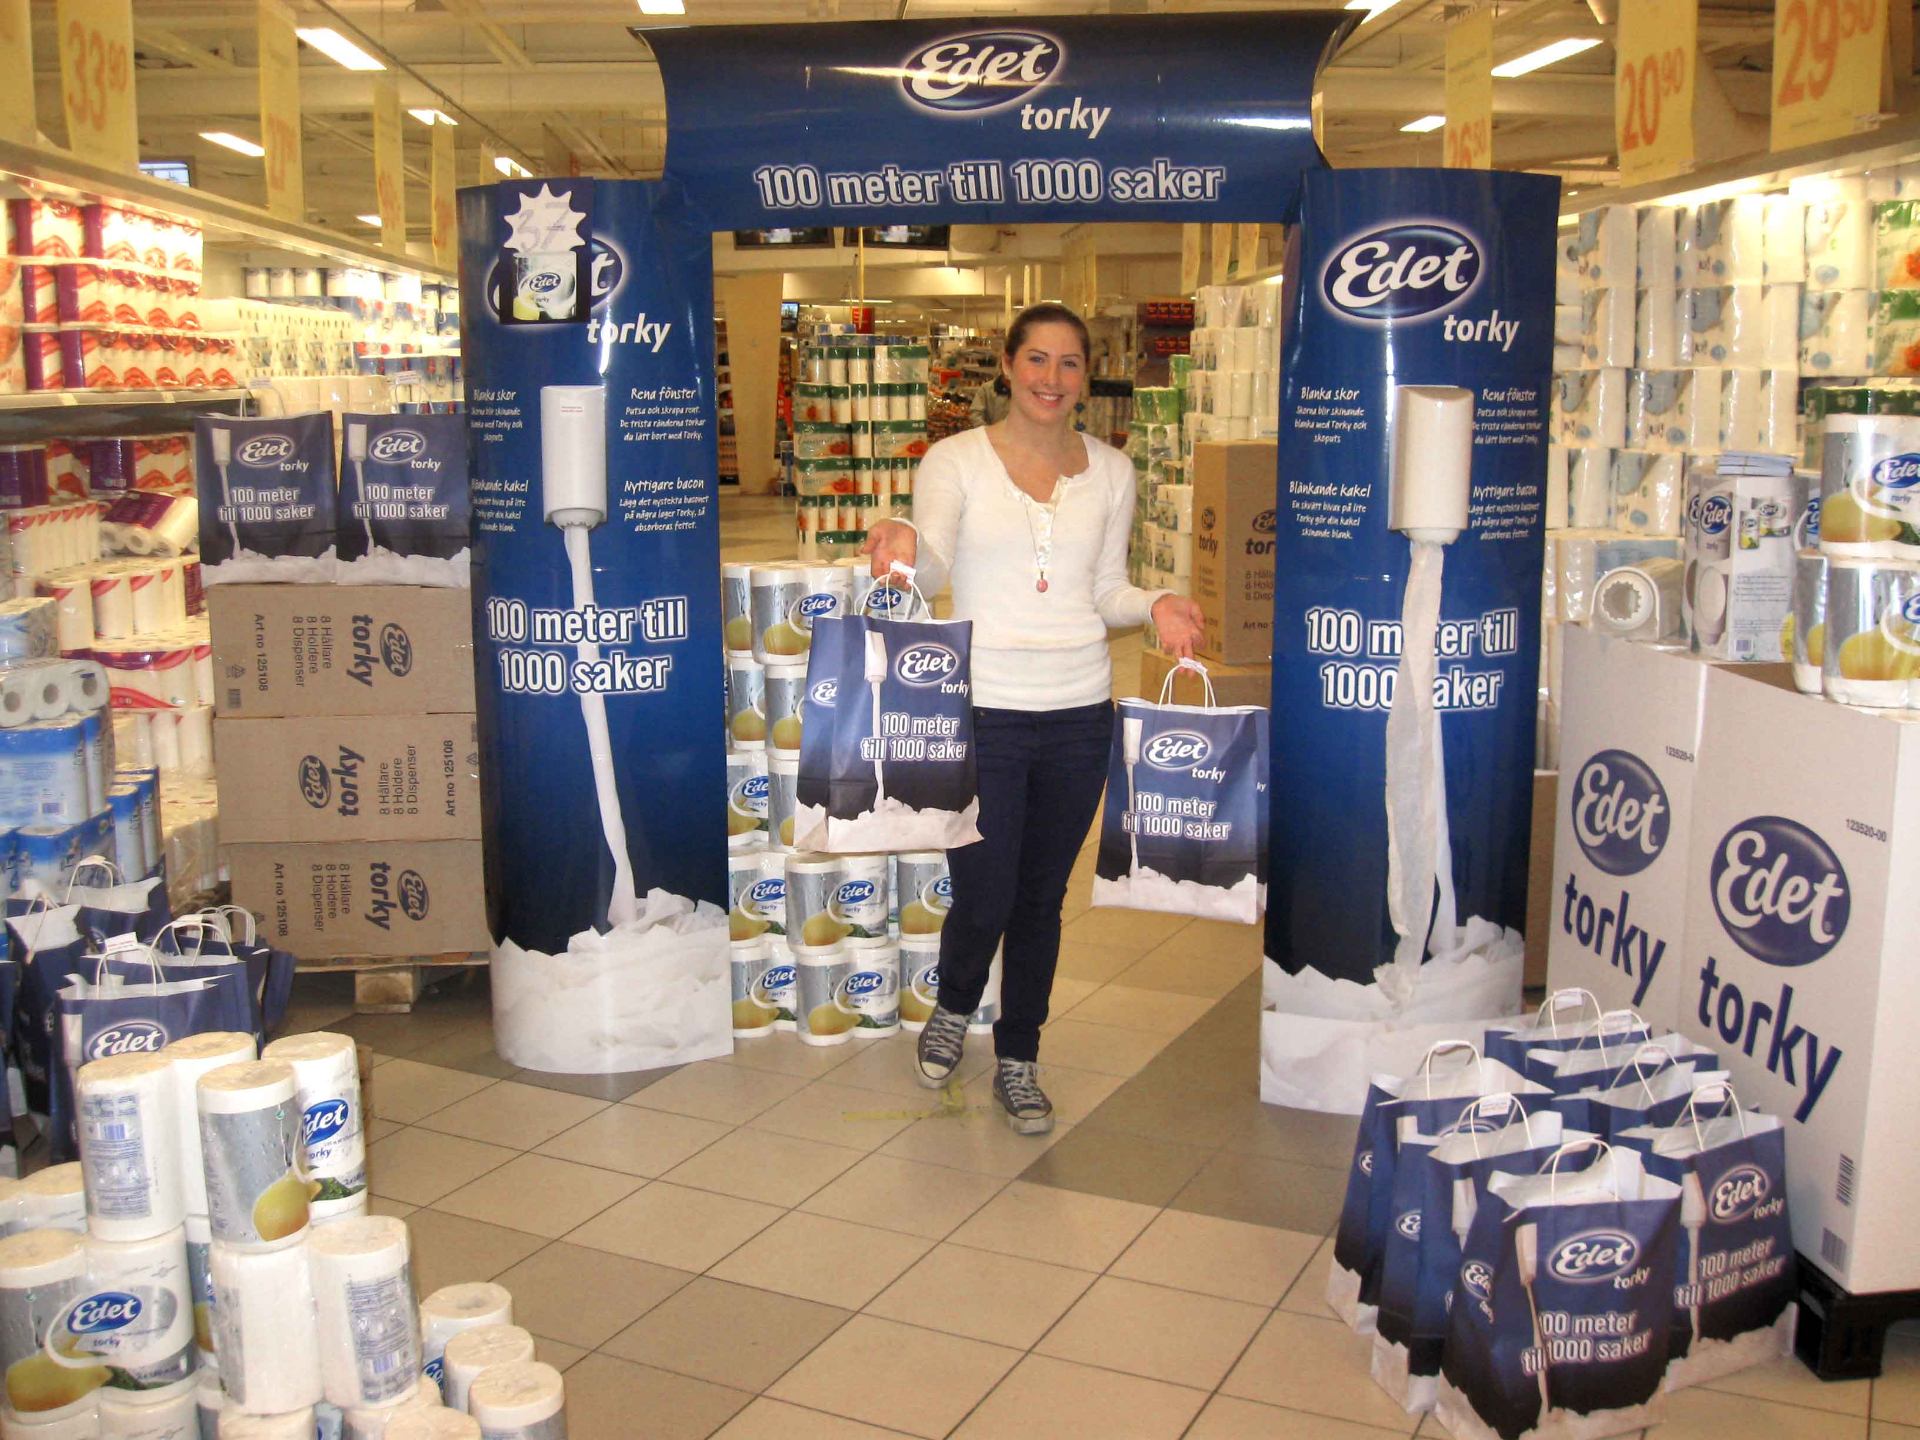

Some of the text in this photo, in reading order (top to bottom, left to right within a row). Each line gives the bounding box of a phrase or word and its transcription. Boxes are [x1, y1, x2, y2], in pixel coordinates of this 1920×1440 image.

[909, 43, 1052, 100] Edet
[1620, 54, 1660, 152] 20
[1021, 97, 1110, 138] torky
[756, 157, 1224, 208] 100 meter till 1000 saker
[531, 275, 558, 291] Edet
[1332, 241, 1472, 308] Edet
[587, 313, 671, 352] torky
[1444, 309, 1520, 352] torky
[496, 389, 516, 400] skor
[631, 387, 696, 401] Rena fönster
[1302, 387, 1359, 400] Blanka skor
[1483, 388, 1505, 400] Rena
[626, 406, 683, 416] Putsa och skrapa
[1331, 407, 1364, 416] skinande
[620, 419, 629, 427] De
[1332, 421, 1352, 432] Torky
[242, 440, 287, 463] Edet
[374, 436, 418, 459] Edet
[280, 460, 309, 472] torky
[411, 459, 440, 471] torky
[232, 488, 299, 502] 100 meter
[366, 485, 434, 500] 100 meter
[504, 480, 528, 492] kakel
[625, 477, 704, 494] Nyttigare bacon
[1290, 481, 1371, 498] Blänkande kakel
[1473, 485, 1515, 501] Nyttigare
[218, 505, 315, 521] till 1000 saker
[354, 503, 448, 518] till 1000 saker
[1342, 503, 1351, 514] på
[1702, 502, 1731, 527] Edet
[635, 522, 673, 531] absorberas
[1340, 516, 1360, 526] kakel
[801, 595, 835, 612] Edet
[254, 614, 264, 630] Art
[487, 596, 687, 643] 100 meter till
[256, 635, 264, 648] no
[1306, 607, 1517, 658] 100 mer till
[292, 628, 304, 687] Dispenser
[307, 628, 319, 674] Holdere
[347, 615, 380, 687] torky
[500, 650, 672, 694] 1000 saker
[901, 651, 953, 678] Edet
[941, 681, 969, 698] torky
[1322, 664, 1503, 711] 1000 aker
[883, 714, 959, 735] 100 meter
[862, 739, 967, 761] till 1000 saker
[1149, 737, 1206, 762] Edet
[332, 745, 365, 817] torky
[392, 758, 403, 803] Holdere
[407, 745, 419, 803] Dispenser
[1192, 767, 1226, 783] torky
[447, 783, 454, 796] no
[446, 799, 456, 817] Art
[1136, 793, 1215, 817] 100 meter
[1575, 763, 1665, 855] Edet
[1123, 812, 1231, 839] till 1000 saker
[274, 863, 284, 879] Art
[276, 882, 284, 895] no
[326, 875, 338, 919] Holdere
[365, 861, 397, 931] torky
[752, 881, 785, 899] Edet
[838, 882, 873, 902] Edet
[1716, 830, 1843, 944] Edet
[310, 875, 324, 932] Dispenser
[1563, 873, 1666, 1008] torky
[764, 968, 796, 988] Edet
[846, 973, 881, 992] Edet
[92, 1028, 162, 1056] Edet
[1699, 956, 1843, 1124] torky
[310, 1148, 332, 1160] orky
[1715, 1174, 1762, 1216] Edet
[1754, 1198, 1784, 1219] torky
[1556, 1241, 1631, 1276] Edet
[1700, 1236, 1776, 1277] 100 meter
[1614, 1267, 1651, 1289] torky
[1675, 1256, 1786, 1308] till 1000 saker
[72, 1299, 137, 1330] Edet
[1574, 1310, 1638, 1335] meter
[1596, 1327, 1653, 1361] saker
